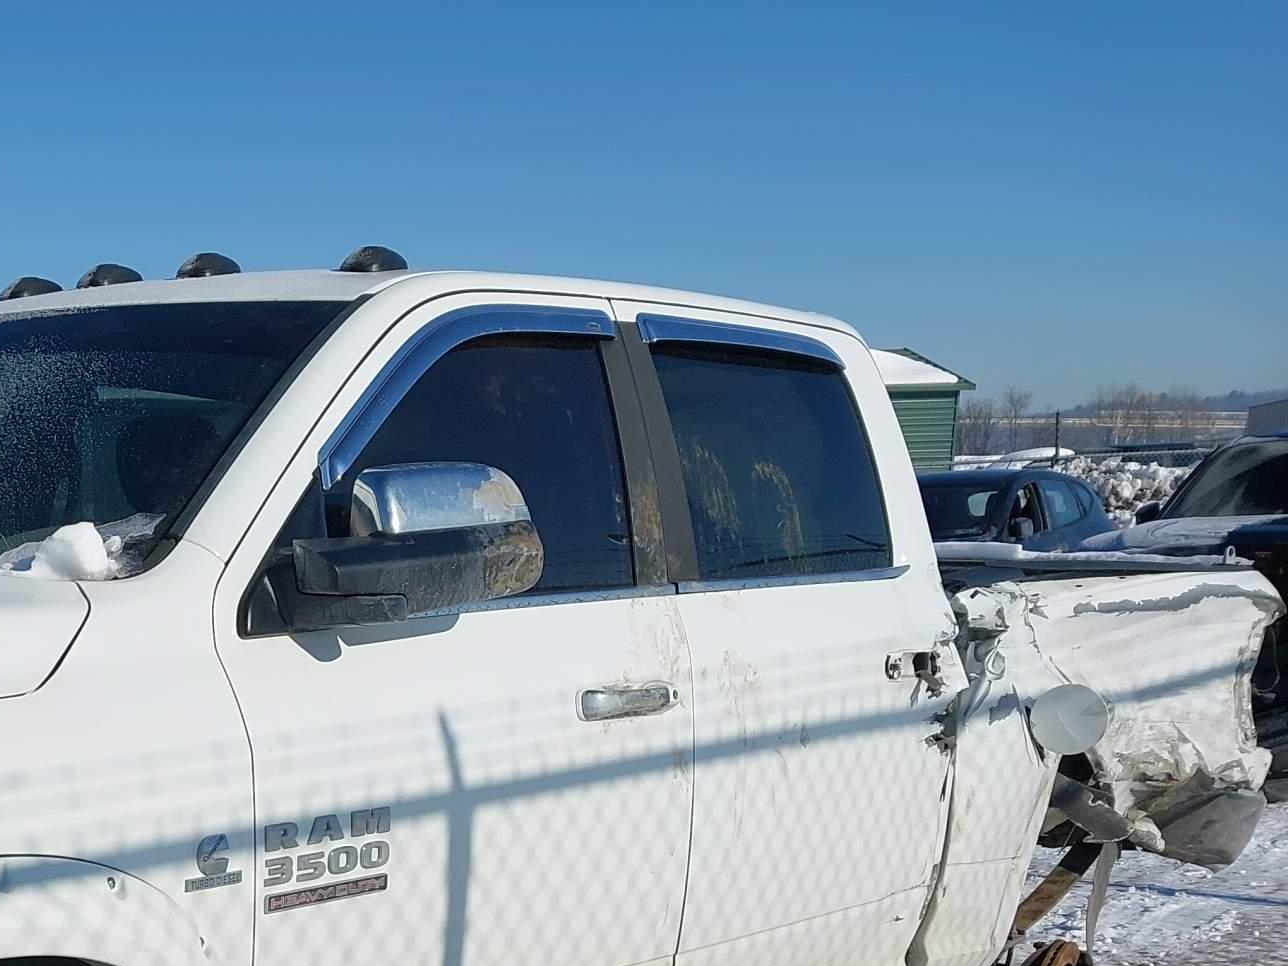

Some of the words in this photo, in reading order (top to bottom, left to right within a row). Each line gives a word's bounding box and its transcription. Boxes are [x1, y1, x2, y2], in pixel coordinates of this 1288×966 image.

[264, 806, 391, 853] RAM
[191, 876, 215, 890] TURBO
[215, 871, 242, 888] DIESEL
[264, 840, 390, 888] 3500
[270, 886, 335, 910] HEAVY
[335, 876, 386, 897] DUTY
